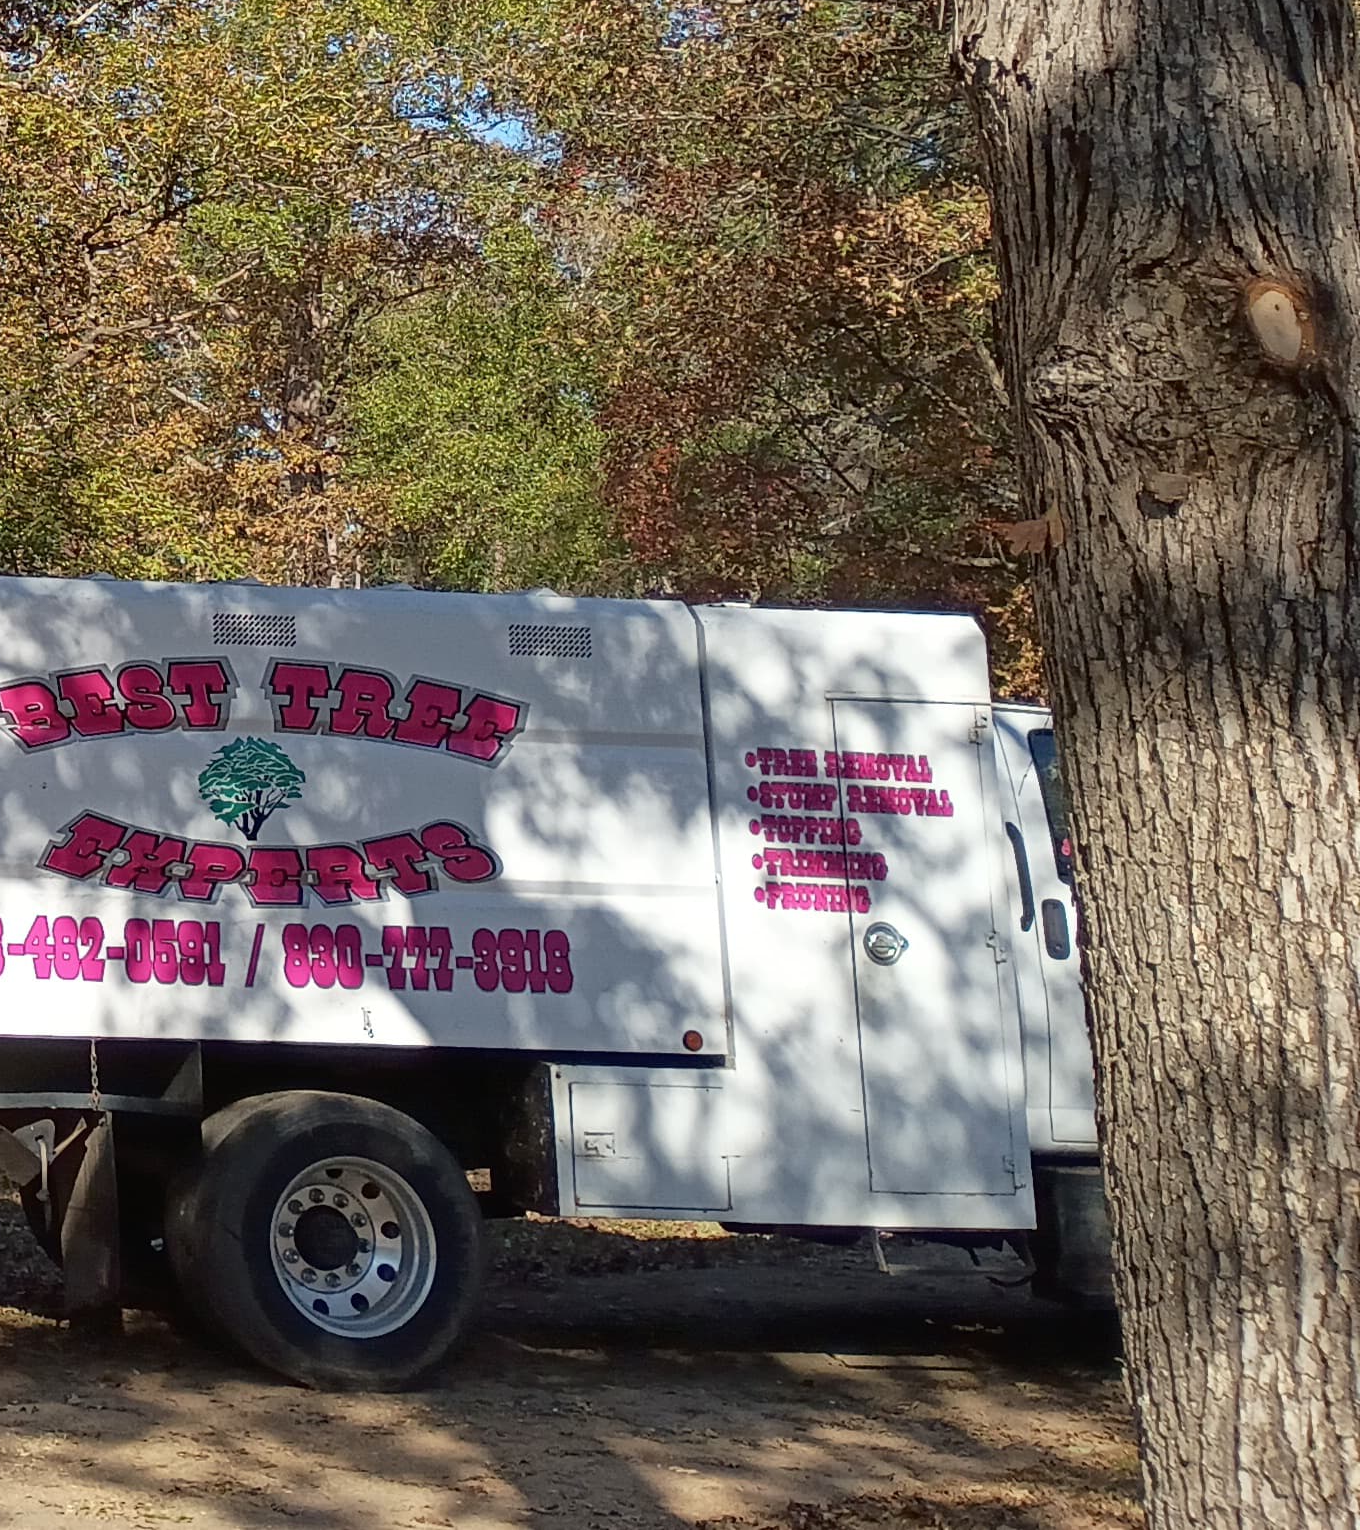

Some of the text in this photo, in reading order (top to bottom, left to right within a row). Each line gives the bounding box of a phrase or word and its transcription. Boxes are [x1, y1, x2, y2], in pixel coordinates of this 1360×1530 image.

[266, 659, 524, 765] TREE
[757, 747, 933, 783] TREE REMOVAL
[759, 781, 954, 817] STUMP REMOVAL
[761, 814, 863, 846] TOPPING
[40, 811, 499, 907] EXPERTS
[763, 847, 889, 881] TRIMMING
[765, 881, 872, 914] PRUNING
